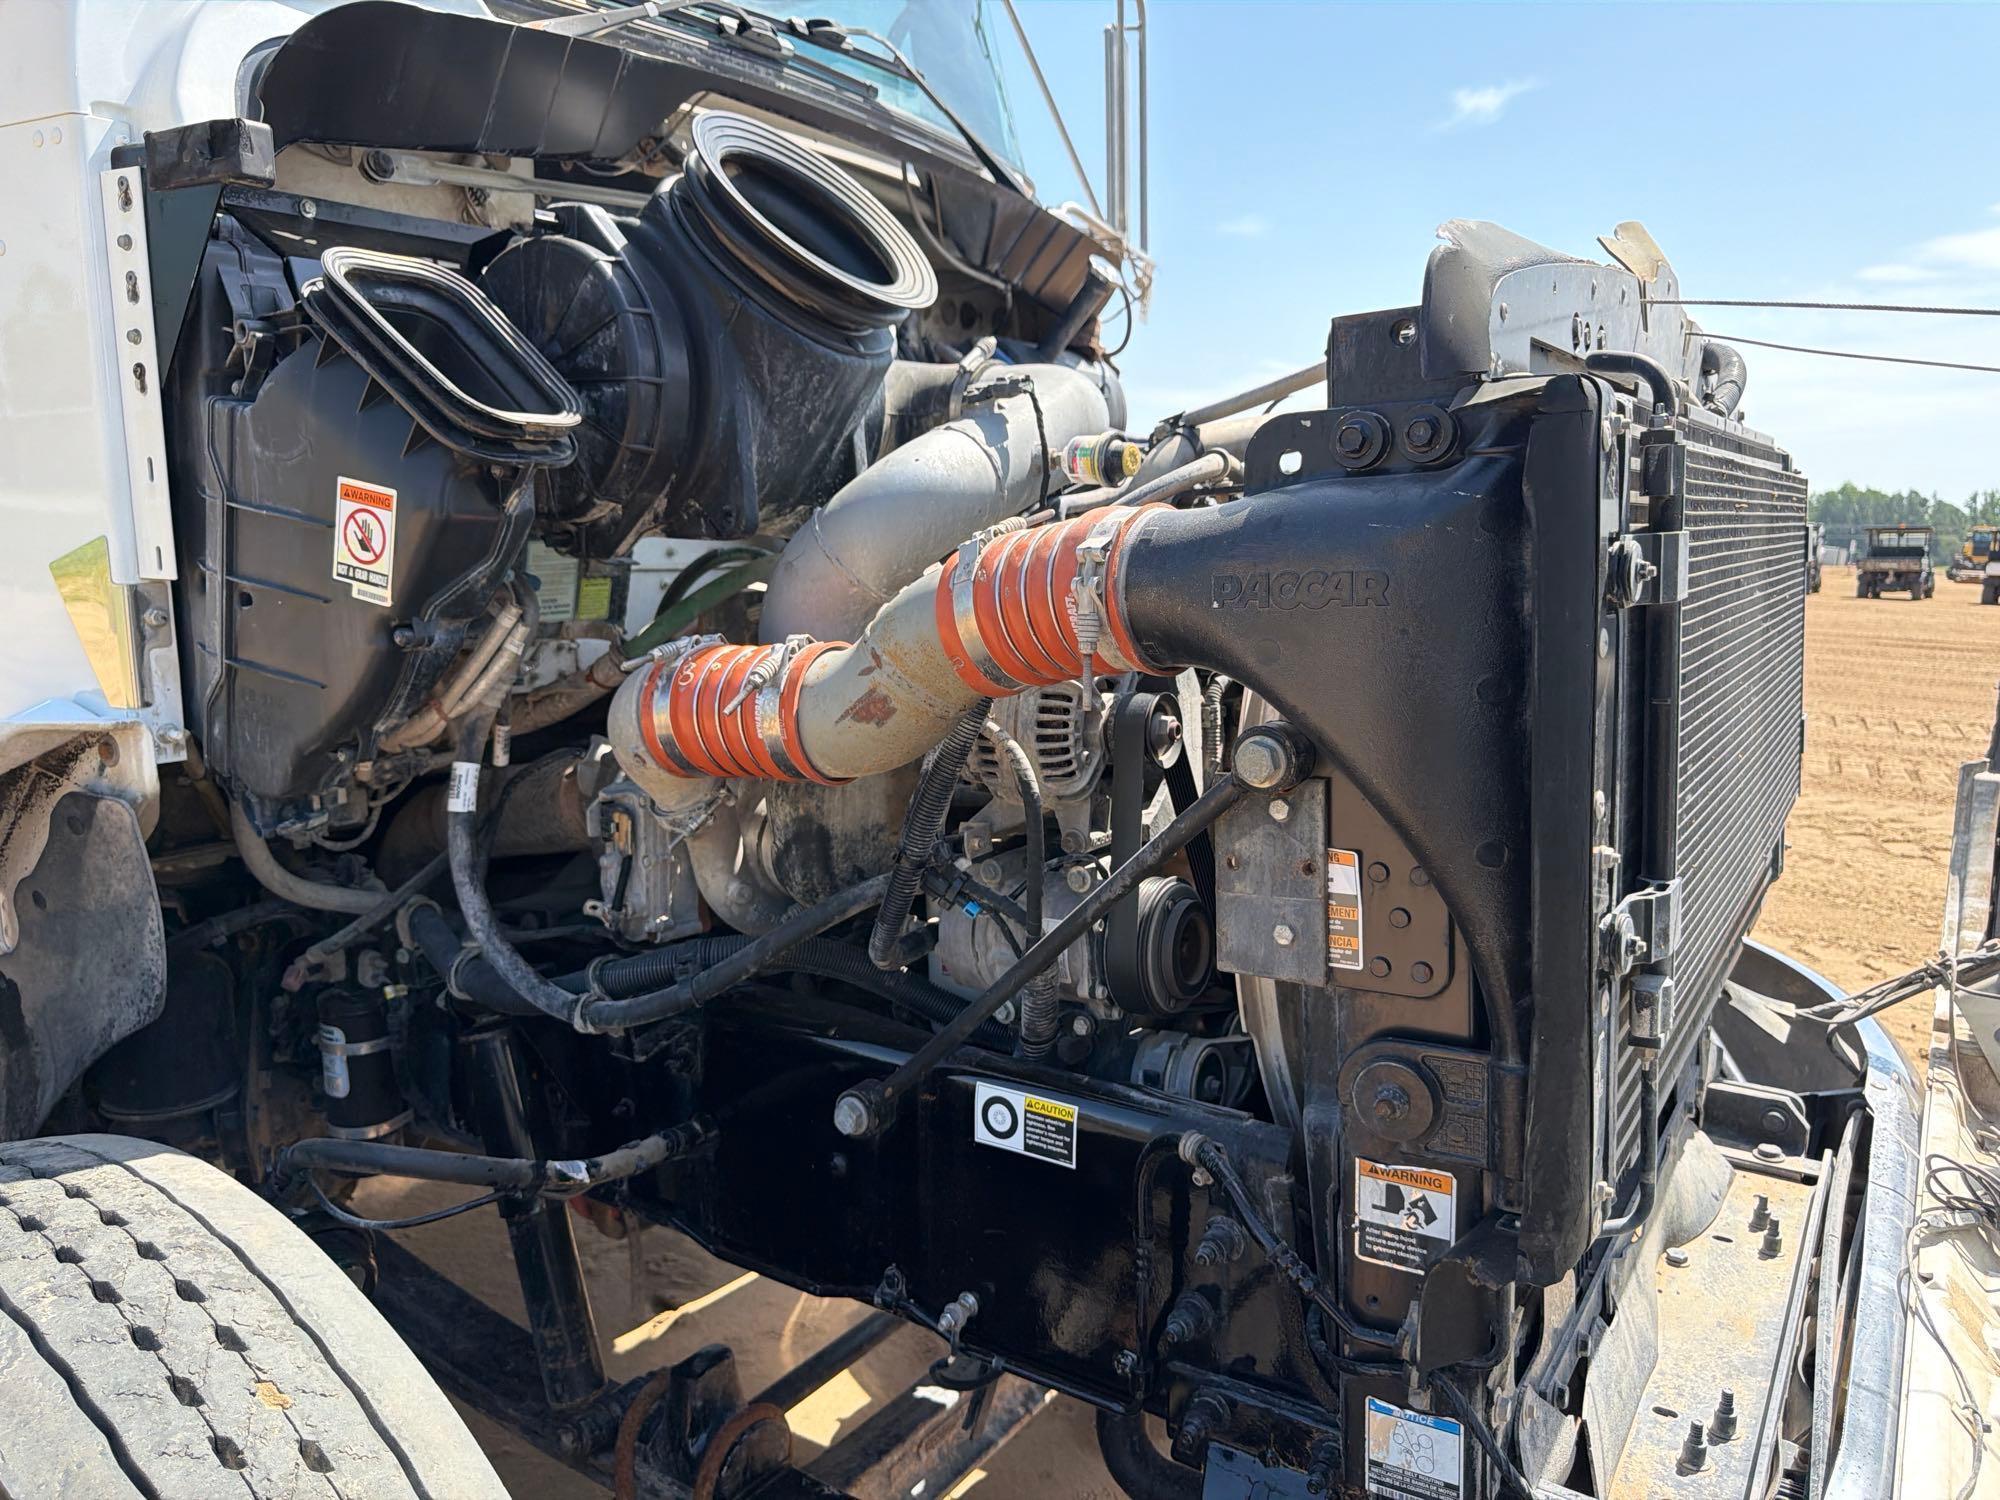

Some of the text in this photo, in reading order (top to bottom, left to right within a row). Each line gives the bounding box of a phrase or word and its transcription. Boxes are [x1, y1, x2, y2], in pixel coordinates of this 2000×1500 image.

[351, 488, 391, 508] WARNING
[1212, 570, 1390, 610] PACCAR
[1034, 1101, 1074, 1119] CAUTION
[1379, 1167, 1442, 1189] WARNING
[1365, 1226, 1380, 1235] After
[1365, 1235, 1428, 1254] secure safety device
[1383, 1464, 1444, 1486] ENGINE BELT ROUTING
